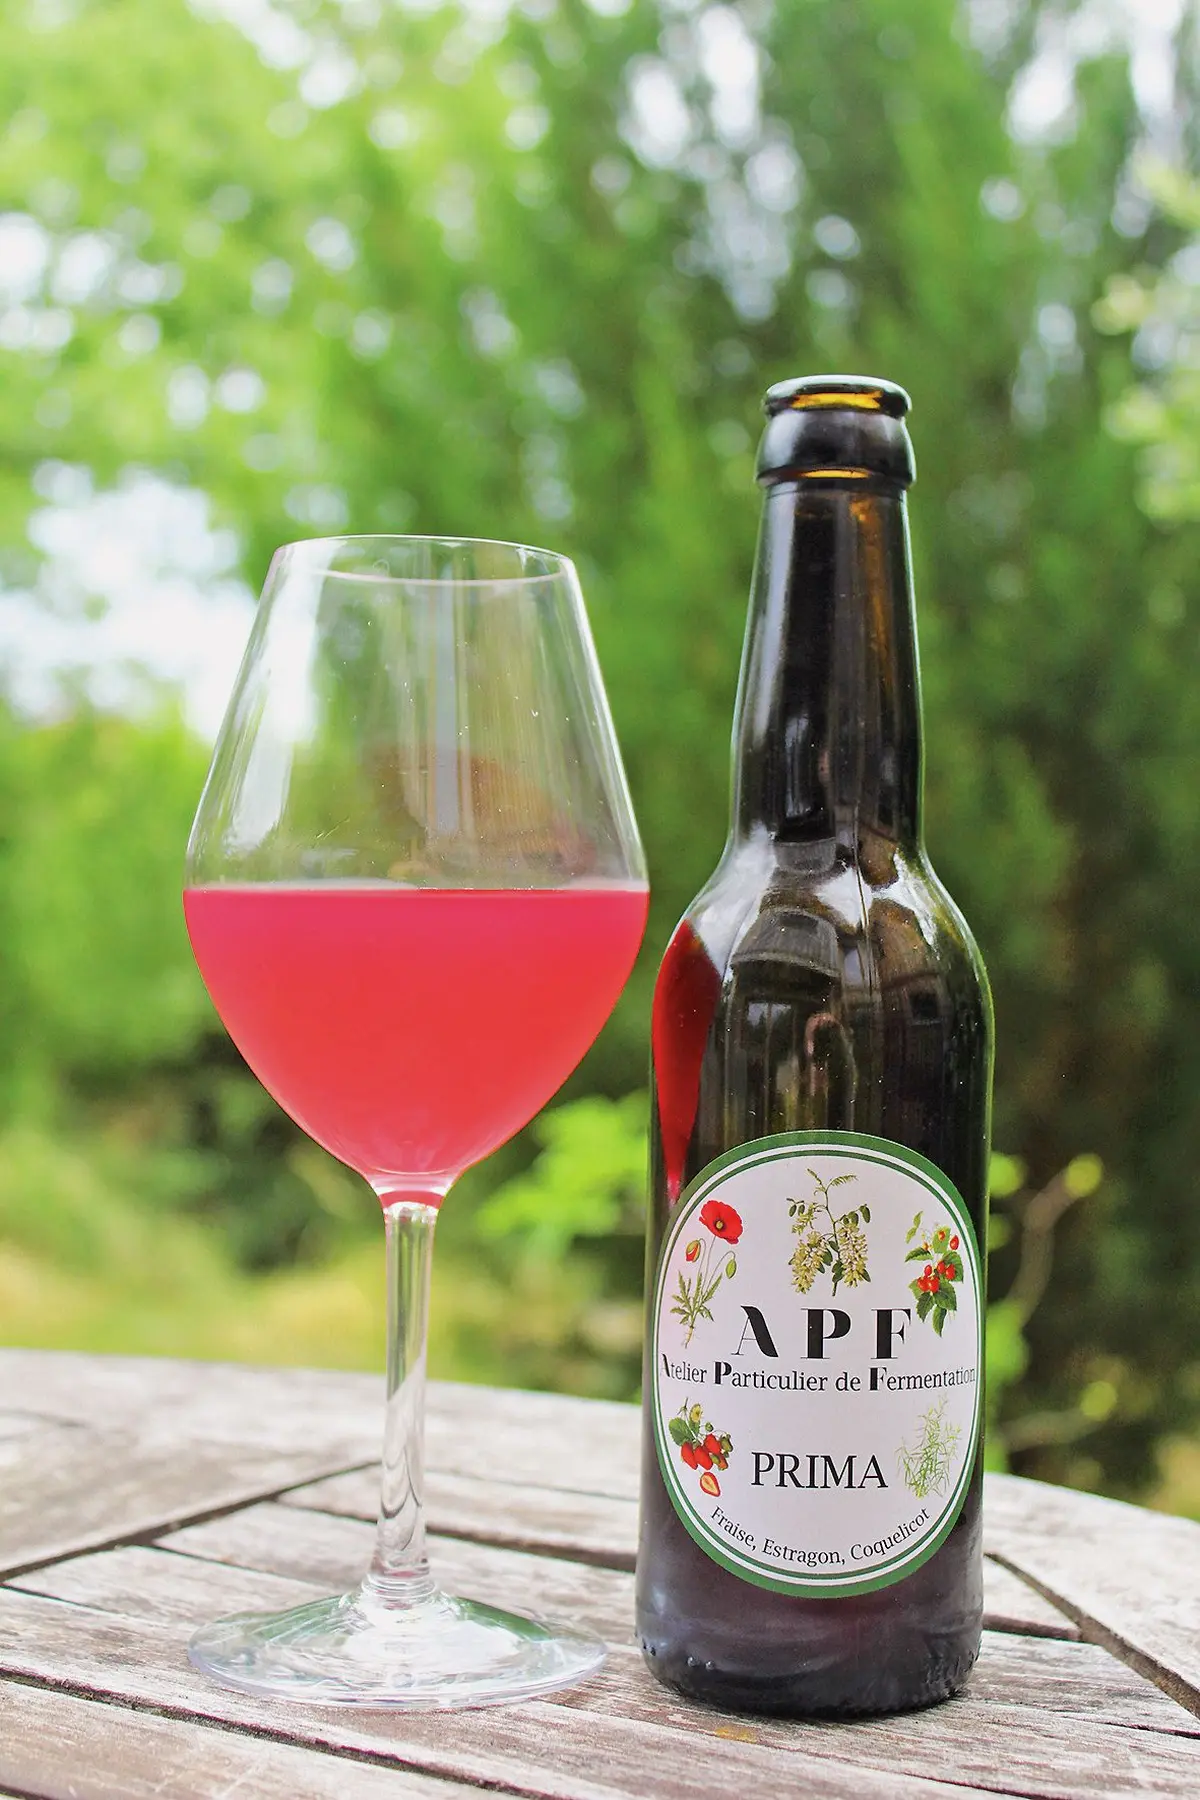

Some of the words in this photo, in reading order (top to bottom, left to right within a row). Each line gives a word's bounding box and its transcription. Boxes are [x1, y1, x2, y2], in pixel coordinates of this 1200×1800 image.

[661, 1353, 708, 1384] Atelier
[714, 1361, 828, 1392] Particulier
[835, 1371, 861, 1392] de
[868, 1366, 976, 1392] Fermentation
[751, 1451, 889, 1489] PRIMA
[710, 1506, 757, 1552] Fraise,
[761, 1538, 845, 1568] Estragon,
[850, 1507, 931, 1561] Coquelicot
